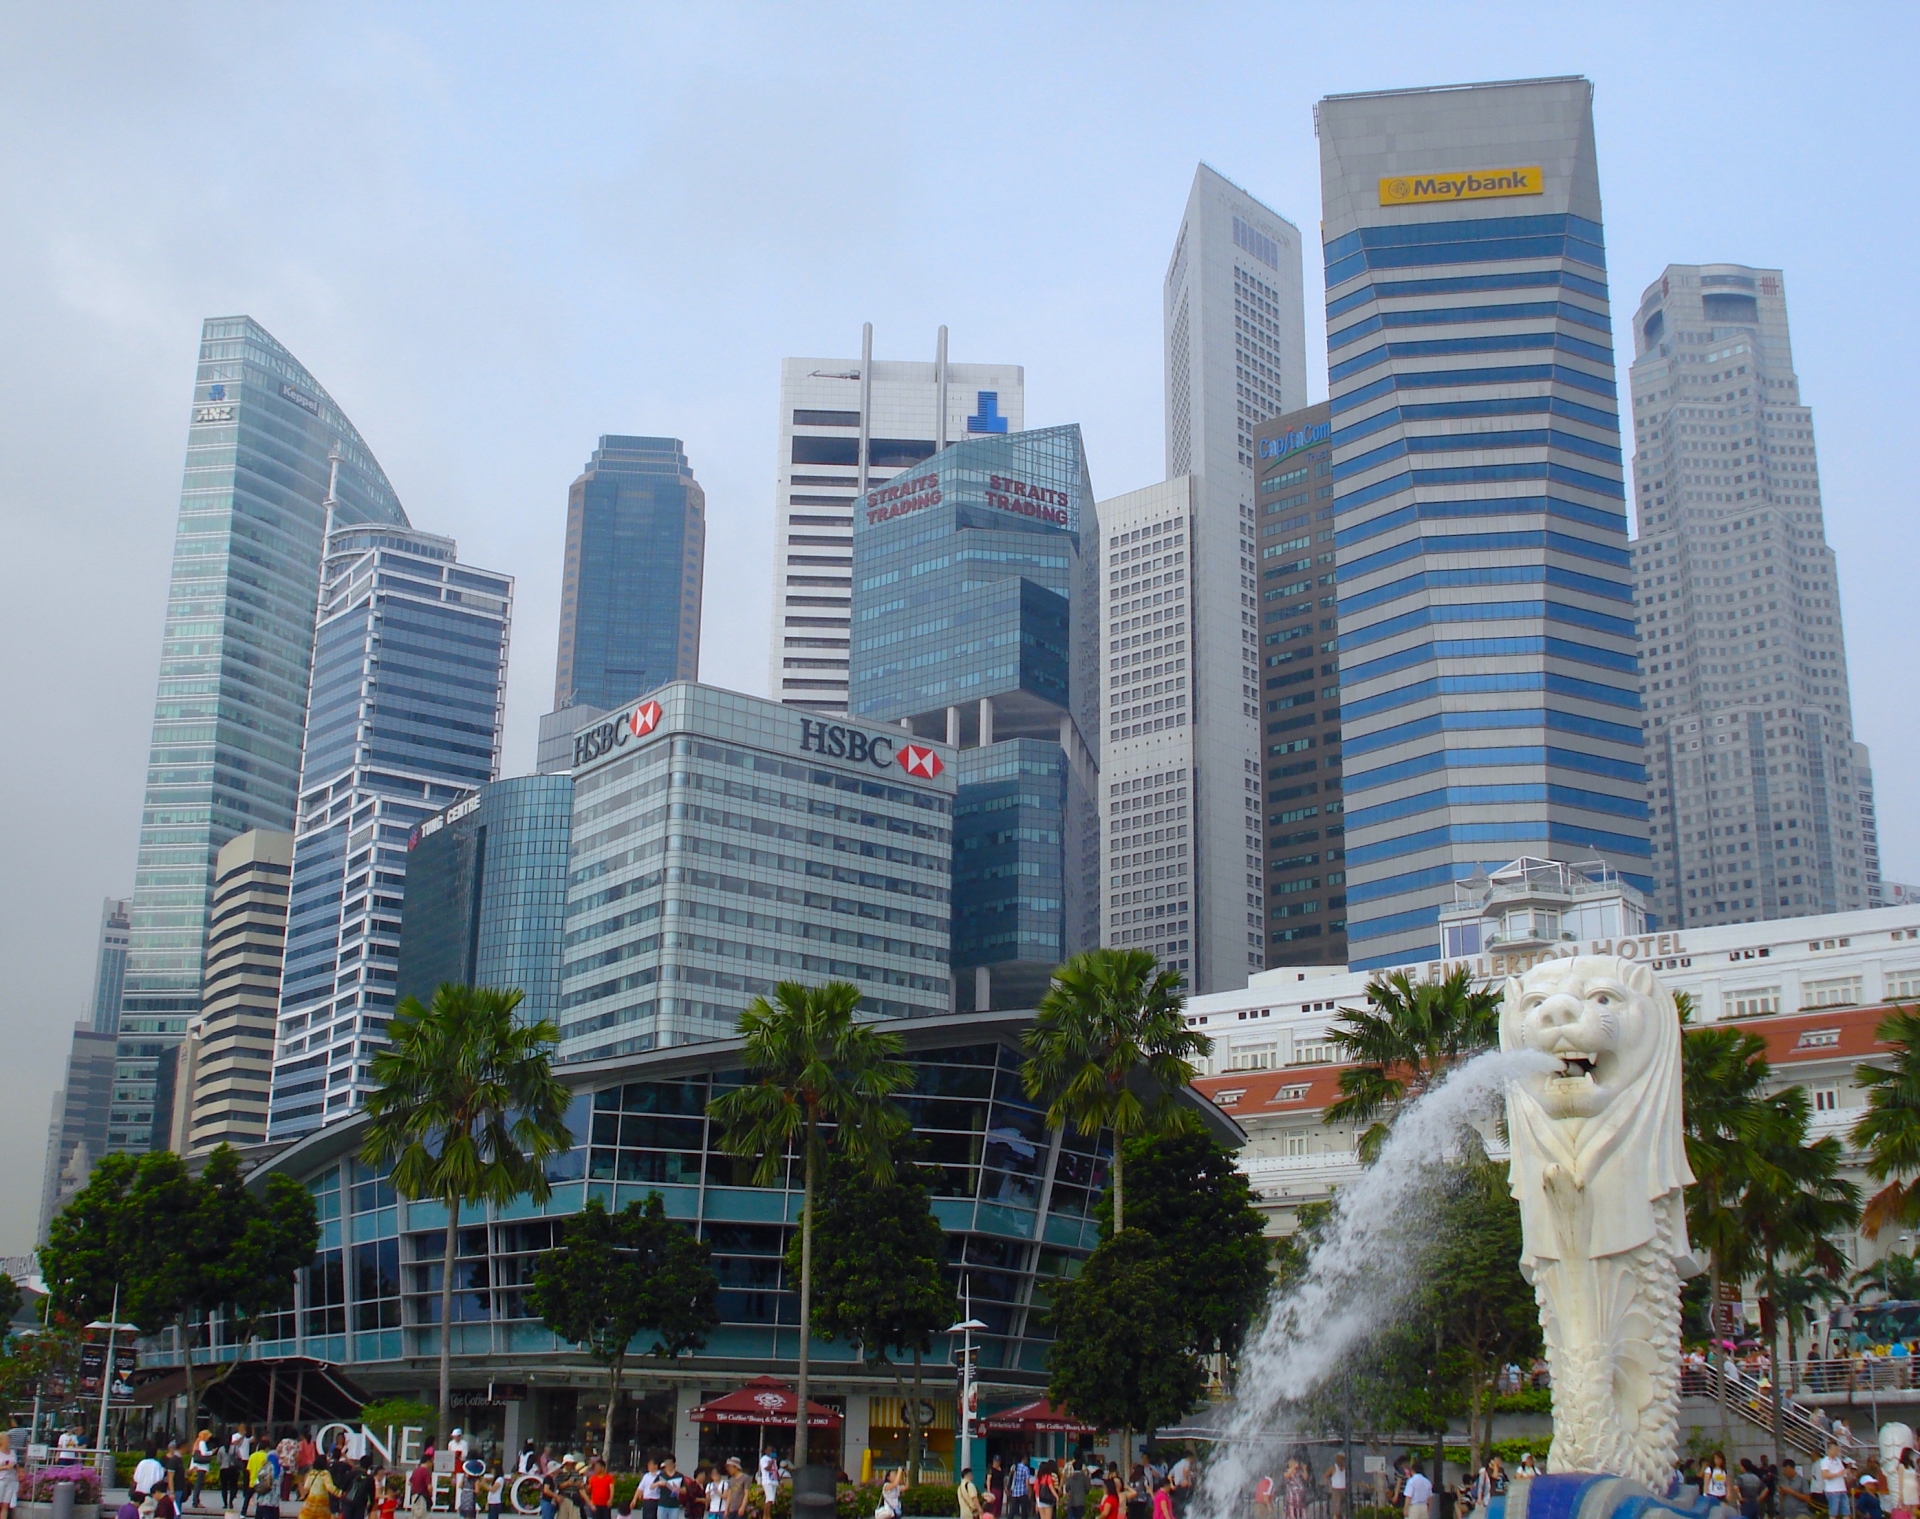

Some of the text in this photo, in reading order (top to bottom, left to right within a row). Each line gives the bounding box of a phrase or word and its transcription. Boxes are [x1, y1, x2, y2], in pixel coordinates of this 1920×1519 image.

[1413, 171, 1528, 197] Maybank
[196, 406, 234, 422] ANZ
[283, 385, 318, 412] Keppel
[866, 489, 943, 525] TRADING
[867, 473, 939, 508] STRAITS
[985, 490, 1069, 525] TRADING
[989, 475, 1069, 507] STRAITS
[572, 712, 629, 768] HSBC
[800, 717, 893, 768] HSBC
[420, 793, 482, 839] TUNG CENTRE
[1368, 966, 1417, 988] THE
[1591, 932, 1687, 960] HOTEL
[465, 1392, 489, 1406] Coffee
[716, 1413, 728, 1421] The
[746, 1415, 764, 1423] Bean
[1036, 1422, 1046, 1430] The
[1064, 1423, 1081, 1431] Bean
[315, 1422, 424, 1465] ONE
